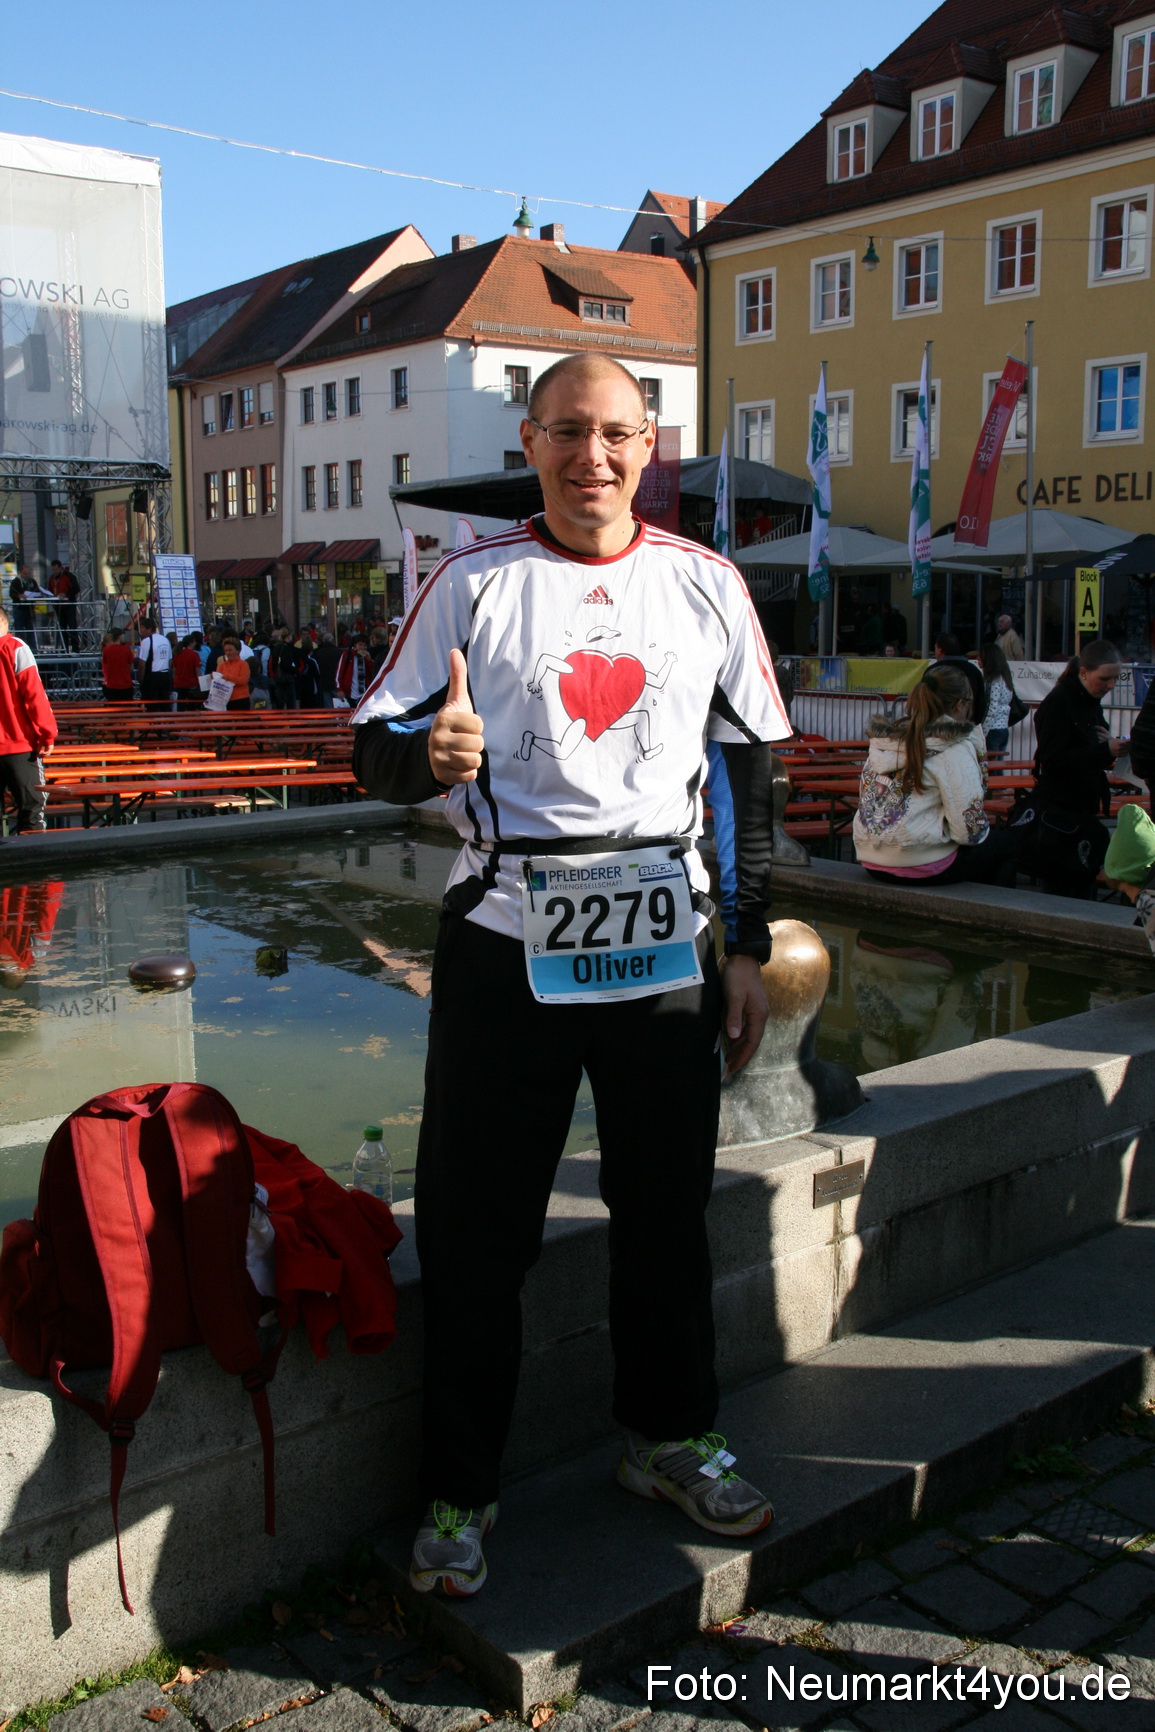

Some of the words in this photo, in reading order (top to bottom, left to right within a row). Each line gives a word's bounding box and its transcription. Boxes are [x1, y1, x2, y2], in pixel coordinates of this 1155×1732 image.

[94, 287, 130, 309] AG
[0, 417, 98, 435] arowski-ag.de
[1016, 477, 1082, 506] CAFE
[1095, 471, 1153, 503] DELI
[1080, 570, 1098, 582] Block
[582, 597, 614, 606] adidas
[1081, 586, 1095, 618] A
[549, 866, 623, 883] PFLEIDERER
[638, 862, 675, 878] BOCK
[550, 879, 623, 892] AKTIENGESELLSCHAFT
[544, 886, 676, 951] 2279
[572, 953, 656, 985] Oliver
